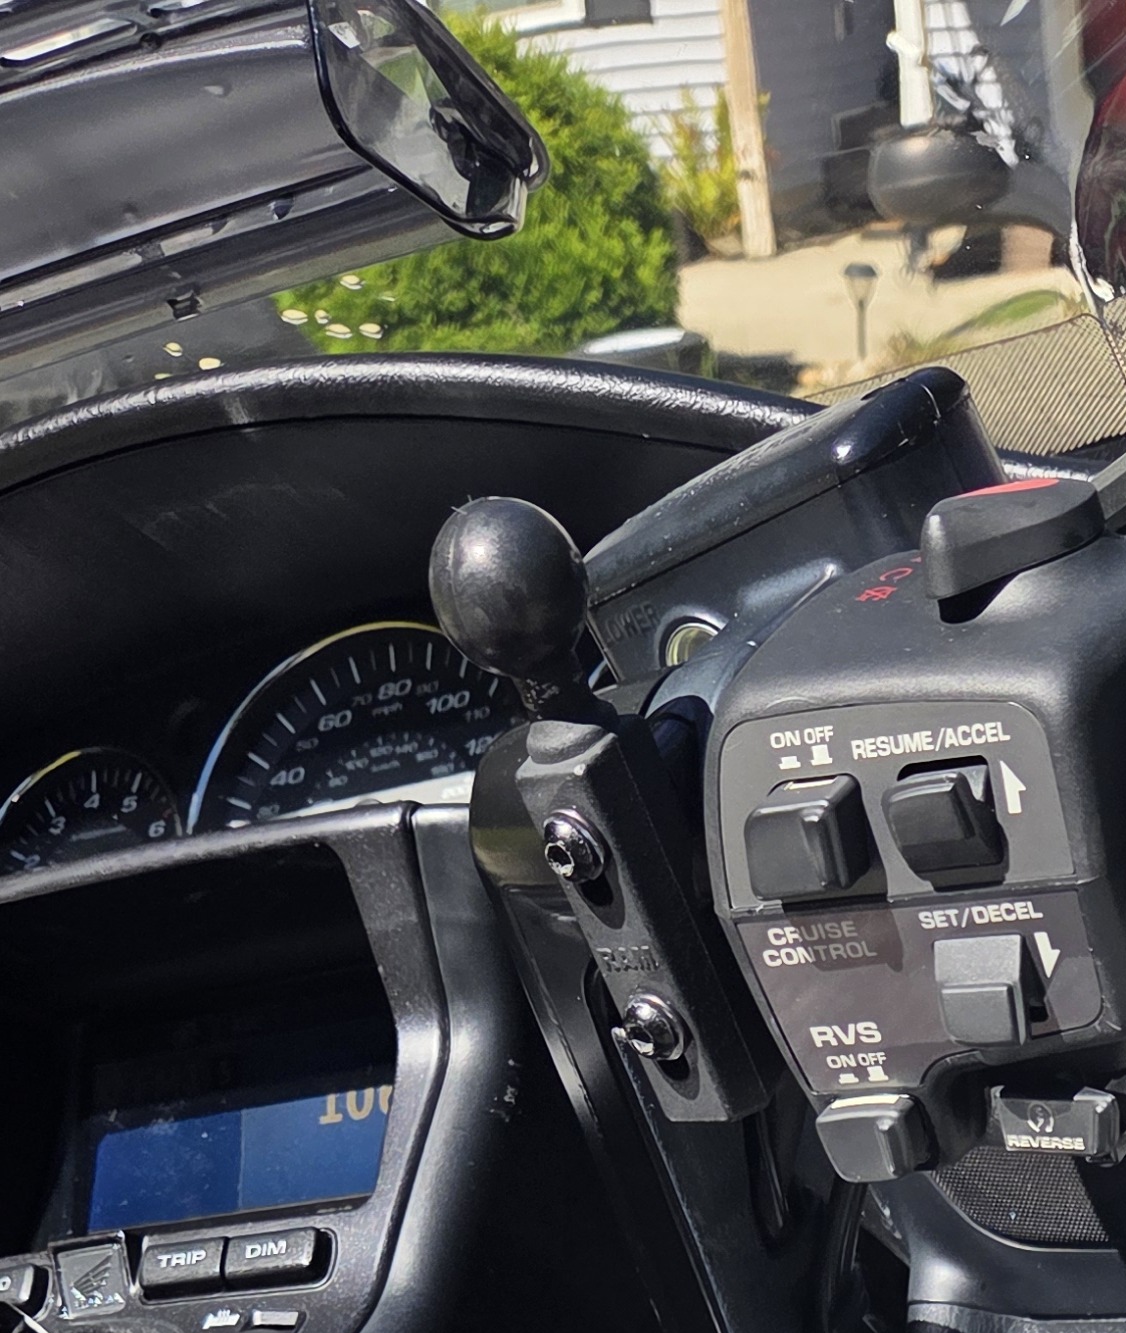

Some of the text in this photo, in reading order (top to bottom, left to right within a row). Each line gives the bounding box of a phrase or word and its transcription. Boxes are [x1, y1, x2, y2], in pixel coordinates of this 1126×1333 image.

[378, 678, 412, 700] 80
[426, 690, 469, 714] 100
[318, 710, 352, 731] 60
[770, 726, 834, 748] ON OFF
[851, 722, 1010, 759] RESUME/ACCEL
[270, 767, 305, 785] 40
[83, 793, 100, 809] 4
[121, 795, 138, 813] 5
[48, 816, 66, 835] 3
[148, 819, 166, 838] 6
[919, 902, 1043, 929] SET/DECEL
[767, 921, 858, 946] CRUISE
[762, 940, 877, 967] CONTROL
[810, 1022, 881, 1047] RVS
[826, 1052, 887, 1069] ON OFF
[1006, 1134, 1085, 1150] REVERSE
[158, 1250, 207, 1268] TRIP
[245, 1240, 287, 1259] DIM
